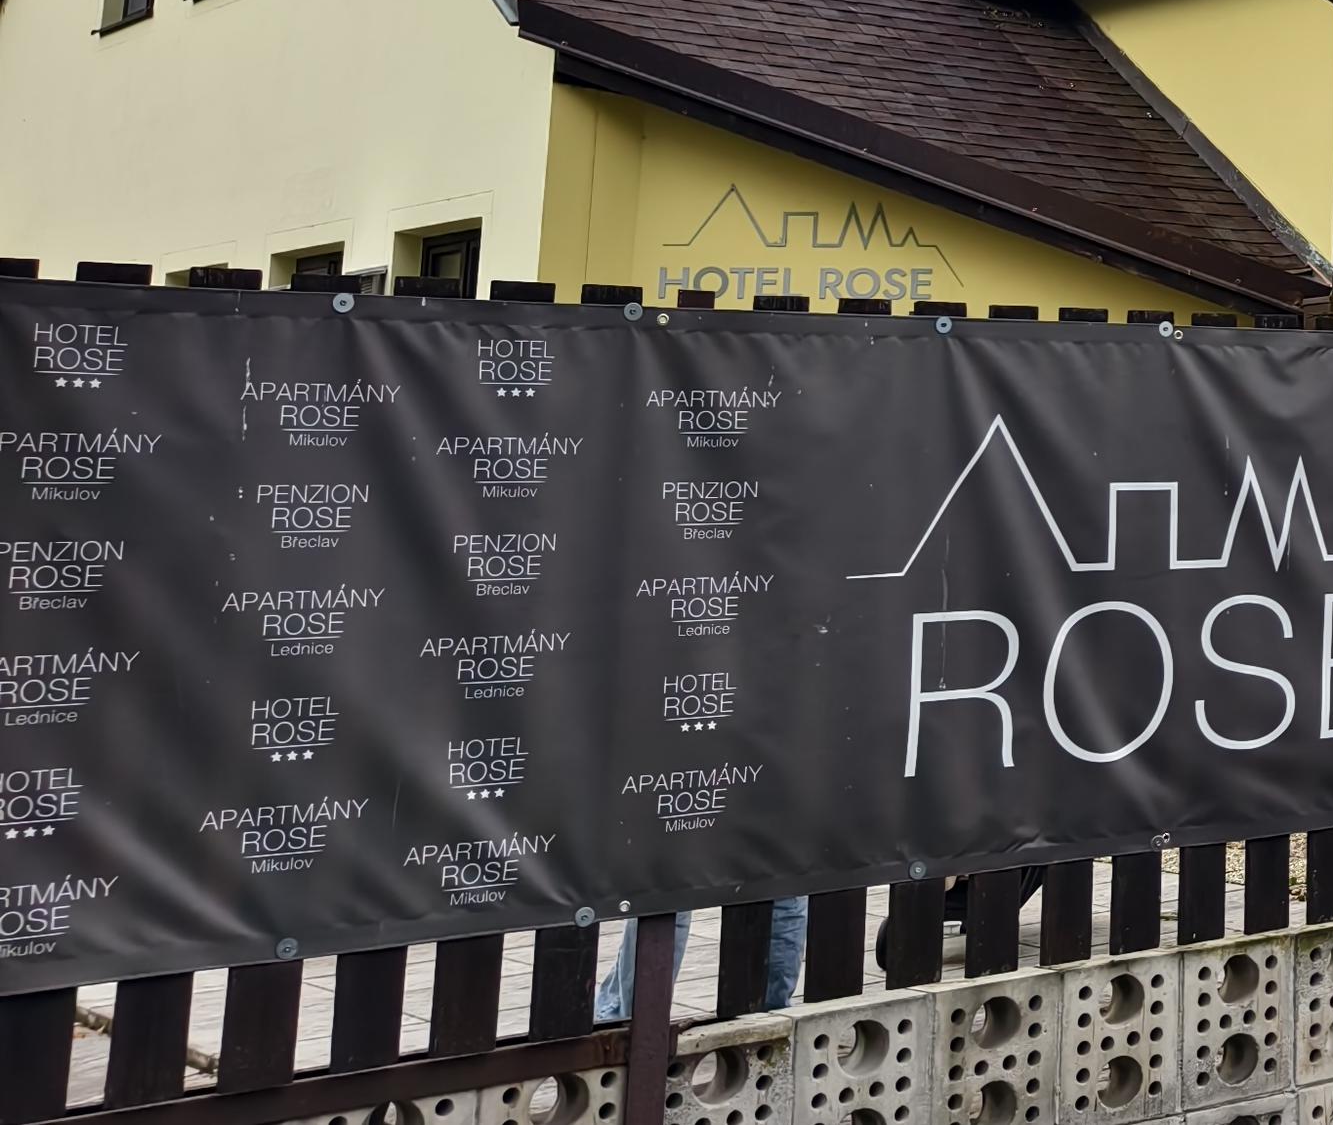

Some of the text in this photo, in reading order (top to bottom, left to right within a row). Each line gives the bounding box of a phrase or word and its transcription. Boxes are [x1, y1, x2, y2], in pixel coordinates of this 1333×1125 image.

[658, 266, 933, 300] HOTEL ROSE
[34, 323, 128, 346] HOTEL
[34, 346, 124, 370] ROSE
[478, 340, 554, 358] HOTEL
[479, 360, 552, 381] ROSE
[241, 379, 400, 403] APARTMÁNY
[646, 387, 781, 407] APARTMÁNY
[280, 405, 360, 427] ROSE
[679, 411, 748, 430] ROSE
[0, 428, 161, 453] PARTMÁNY
[290, 433, 347, 446] Mikulov
[436, 432, 583, 455] APARTMÁNY
[687, 436, 738, 447] Mikulov
[21, 457, 116, 479] ROSE
[474, 458, 548, 479] ROSE
[32, 487, 100, 500] Mikulov
[257, 484, 368, 503] PENZION
[483, 486, 537, 497] Mikulov
[663, 481, 758, 499] PENZION
[272, 507, 352, 528] ROSE
[676, 502, 744, 521] ROSE
[281, 535, 338, 548] Břeclav
[454, 534, 556, 553] PENZION
[684, 528, 732, 539] Břeclav
[9, 565, 104, 588] ROSE
[468, 555, 541, 577] ROSE
[477, 583, 529, 596] Břeclav
[636, 571, 774, 596] APARTMÁNY
[20, 596, 87, 610] Břeclav
[222, 584, 384, 612] APARTMÁNY
[671, 596, 739, 618] ROSE
[263, 612, 344, 635] ROSE
[679, 624, 730, 636] Lednice
[271, 643, 333, 656] Lednice
[420, 629, 570, 657] APARTMÁNY
[0, 647, 139, 676] ARTMÁNY
[458, 656, 534, 679] ROSE
[465, 686, 524, 699] Lednice
[664, 673, 736, 693] HOTEL
[252, 697, 339, 720] HOTEL
[664, 693, 734, 716] ROSE
[5, 711, 77, 726] Lednice
[252, 719, 335, 745] ROSE
[448, 737, 528, 759] HOTEL
[450, 759, 525, 784] ROSE
[622, 763, 763, 794] APARTMÁNY
[658, 788, 727, 814] ROSE
[200, 796, 368, 832] APARTMÁNY
[666, 817, 715, 832] Mikulov
[242, 825, 327, 853] ROSE
[404, 832, 555, 866] APARTMÁNY
[252, 857, 313, 873] Mikulov
[442, 860, 518, 891] ROSE
[0, 875, 118, 907] RTMÁNY
[450, 890, 505, 905] Mikulov
[0, 906, 70, 936] OSE
[0, 941, 56, 957] ikulov
